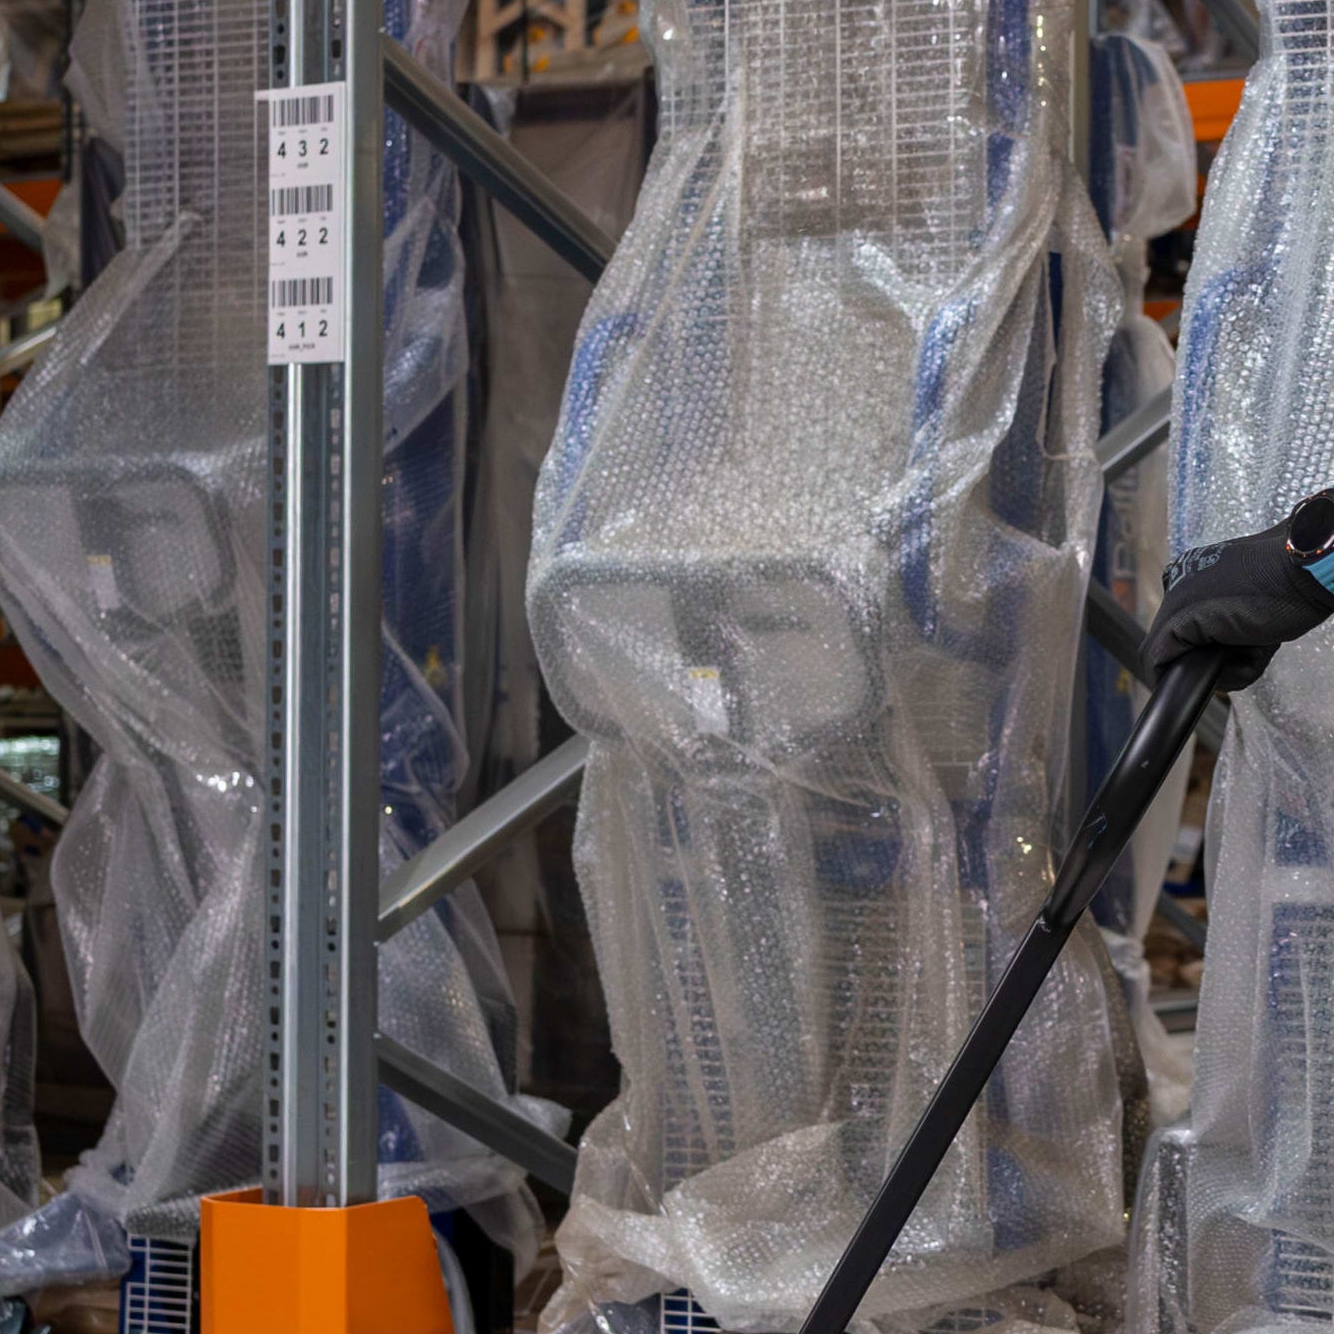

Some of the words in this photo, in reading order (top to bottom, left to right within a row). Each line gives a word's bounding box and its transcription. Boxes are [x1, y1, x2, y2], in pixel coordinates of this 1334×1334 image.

[277, 140, 287, 159] 4
[298, 139, 308, 158] 3
[319, 137, 329, 156] 2
[276, 230, 286, 248] 4
[298, 228, 307, 247] 2
[318, 226, 328, 245] 2
[276, 322, 286, 340] 4
[298, 320, 305, 339] 1
[318, 319, 328, 338] 2
